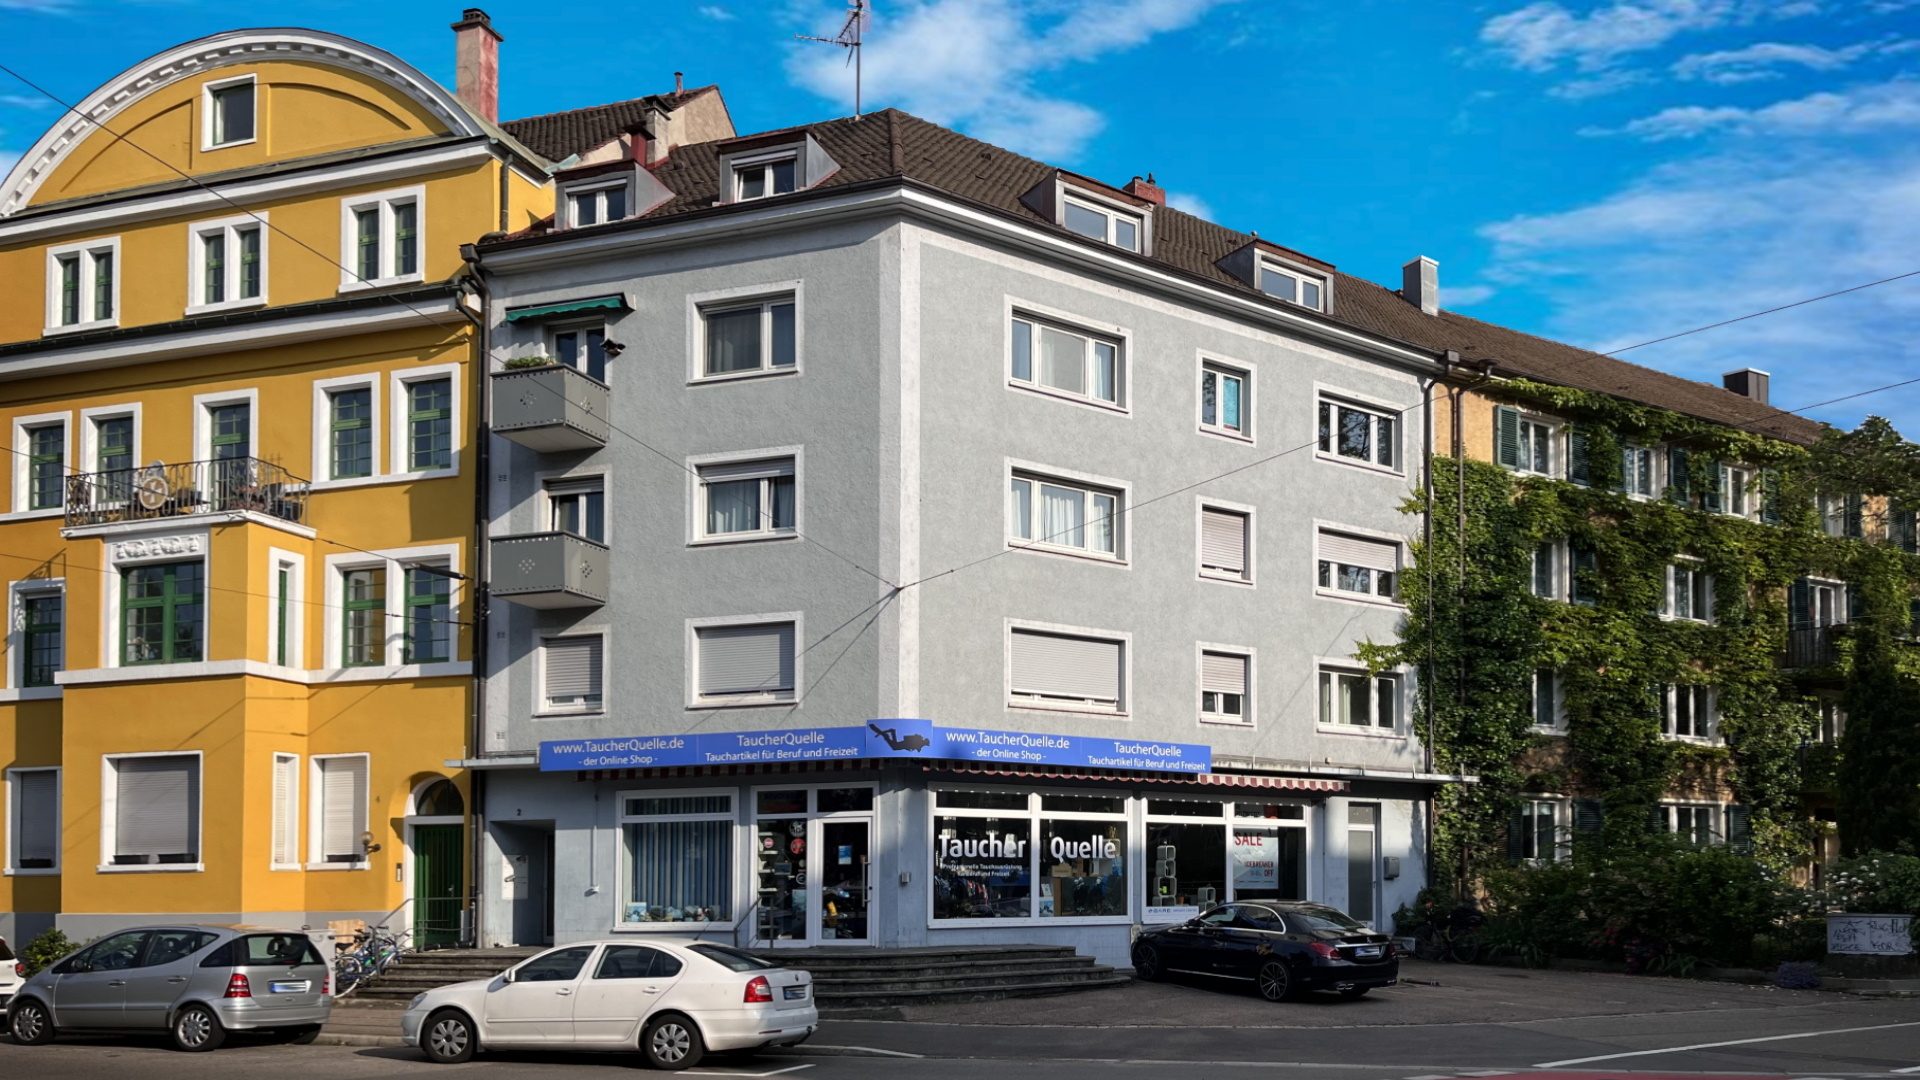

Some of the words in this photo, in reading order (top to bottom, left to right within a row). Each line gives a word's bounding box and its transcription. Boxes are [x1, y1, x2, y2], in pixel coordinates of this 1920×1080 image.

[553, 737, 685, 754] www.TaucherQuelle.de
[736, 731, 825, 747] TaucherQuelle
[946, 731, 1070, 749] www.TaucherQuelle.de
[705, 749, 760, 762] Tauchartikel
[761, 749, 775, 760] für
[777, 749, 801, 759] Beruf
[802, 748, 822, 758] und
[824, 746, 858, 757] Freizeit
[976, 748, 991, 758] der
[992, 748, 1020, 759] Online
[1021, 750, 1041, 761] Shop
[1114, 742, 1182, 757] TaucherQuelle
[583, 757, 598, 766] der
[599, 755, 628, 765] Online
[629, 754, 653, 766] Shop
[1088, 755, 1133, 767] Tauchartikel
[1134, 757, 1145, 767] für
[1145, 759, 1165, 768] Beruf
[1166, 760, 1180, 769] und
[1181, 761, 1206, 771] Freizeit
[1234, 831, 1263, 846] SALE
[938, 832, 1026, 858] Taucher
[1050, 834, 1116, 863] Quelle
